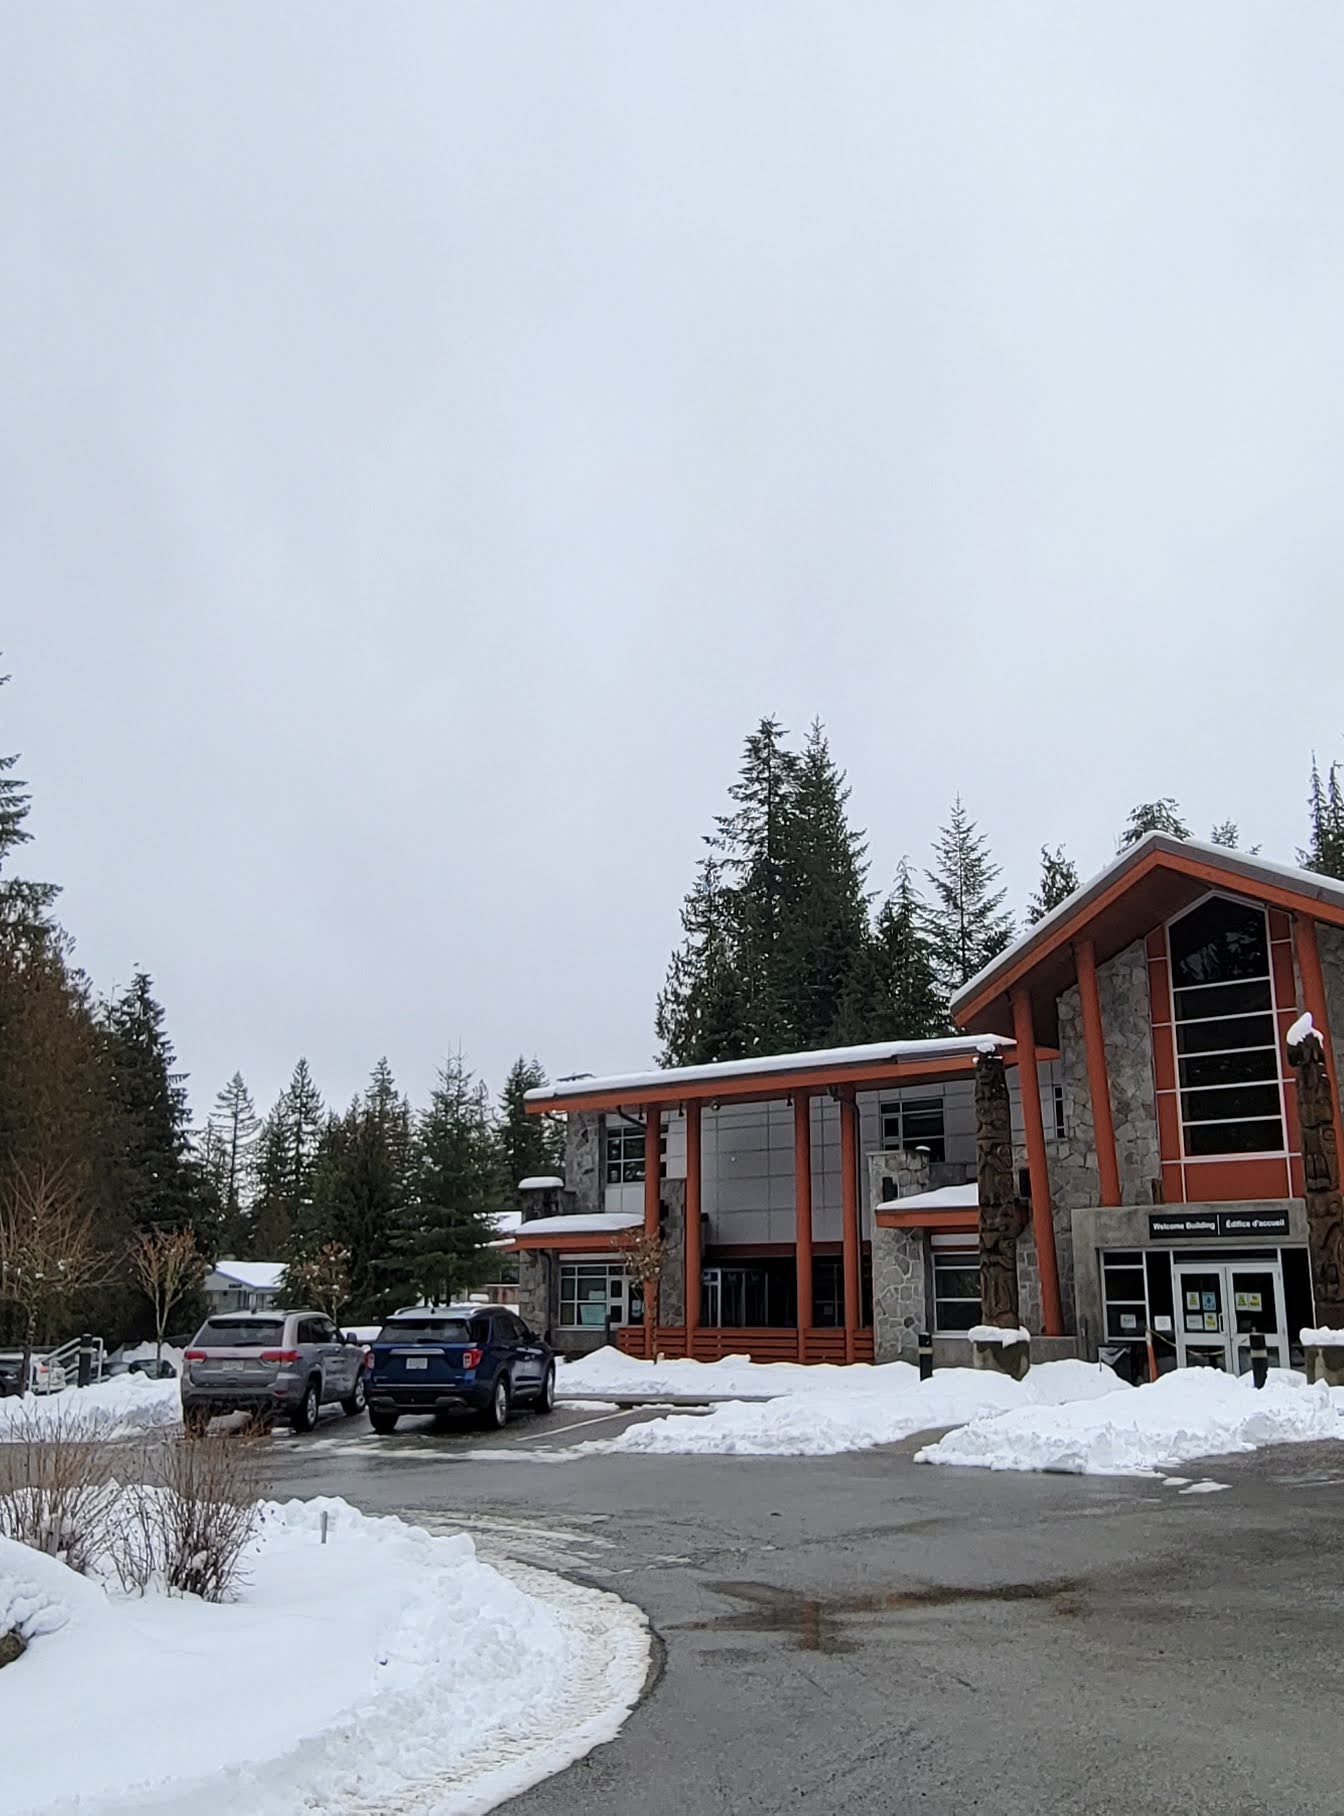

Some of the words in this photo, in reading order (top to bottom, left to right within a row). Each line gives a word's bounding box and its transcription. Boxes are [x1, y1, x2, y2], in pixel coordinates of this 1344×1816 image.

[1153, 1222, 1185, 1231] Welcome
[1186, 1221, 1216, 1231] Building
[1226, 1218, 1251, 1229] Édifice
[1252, 1218, 1285, 1227] d'accueil
